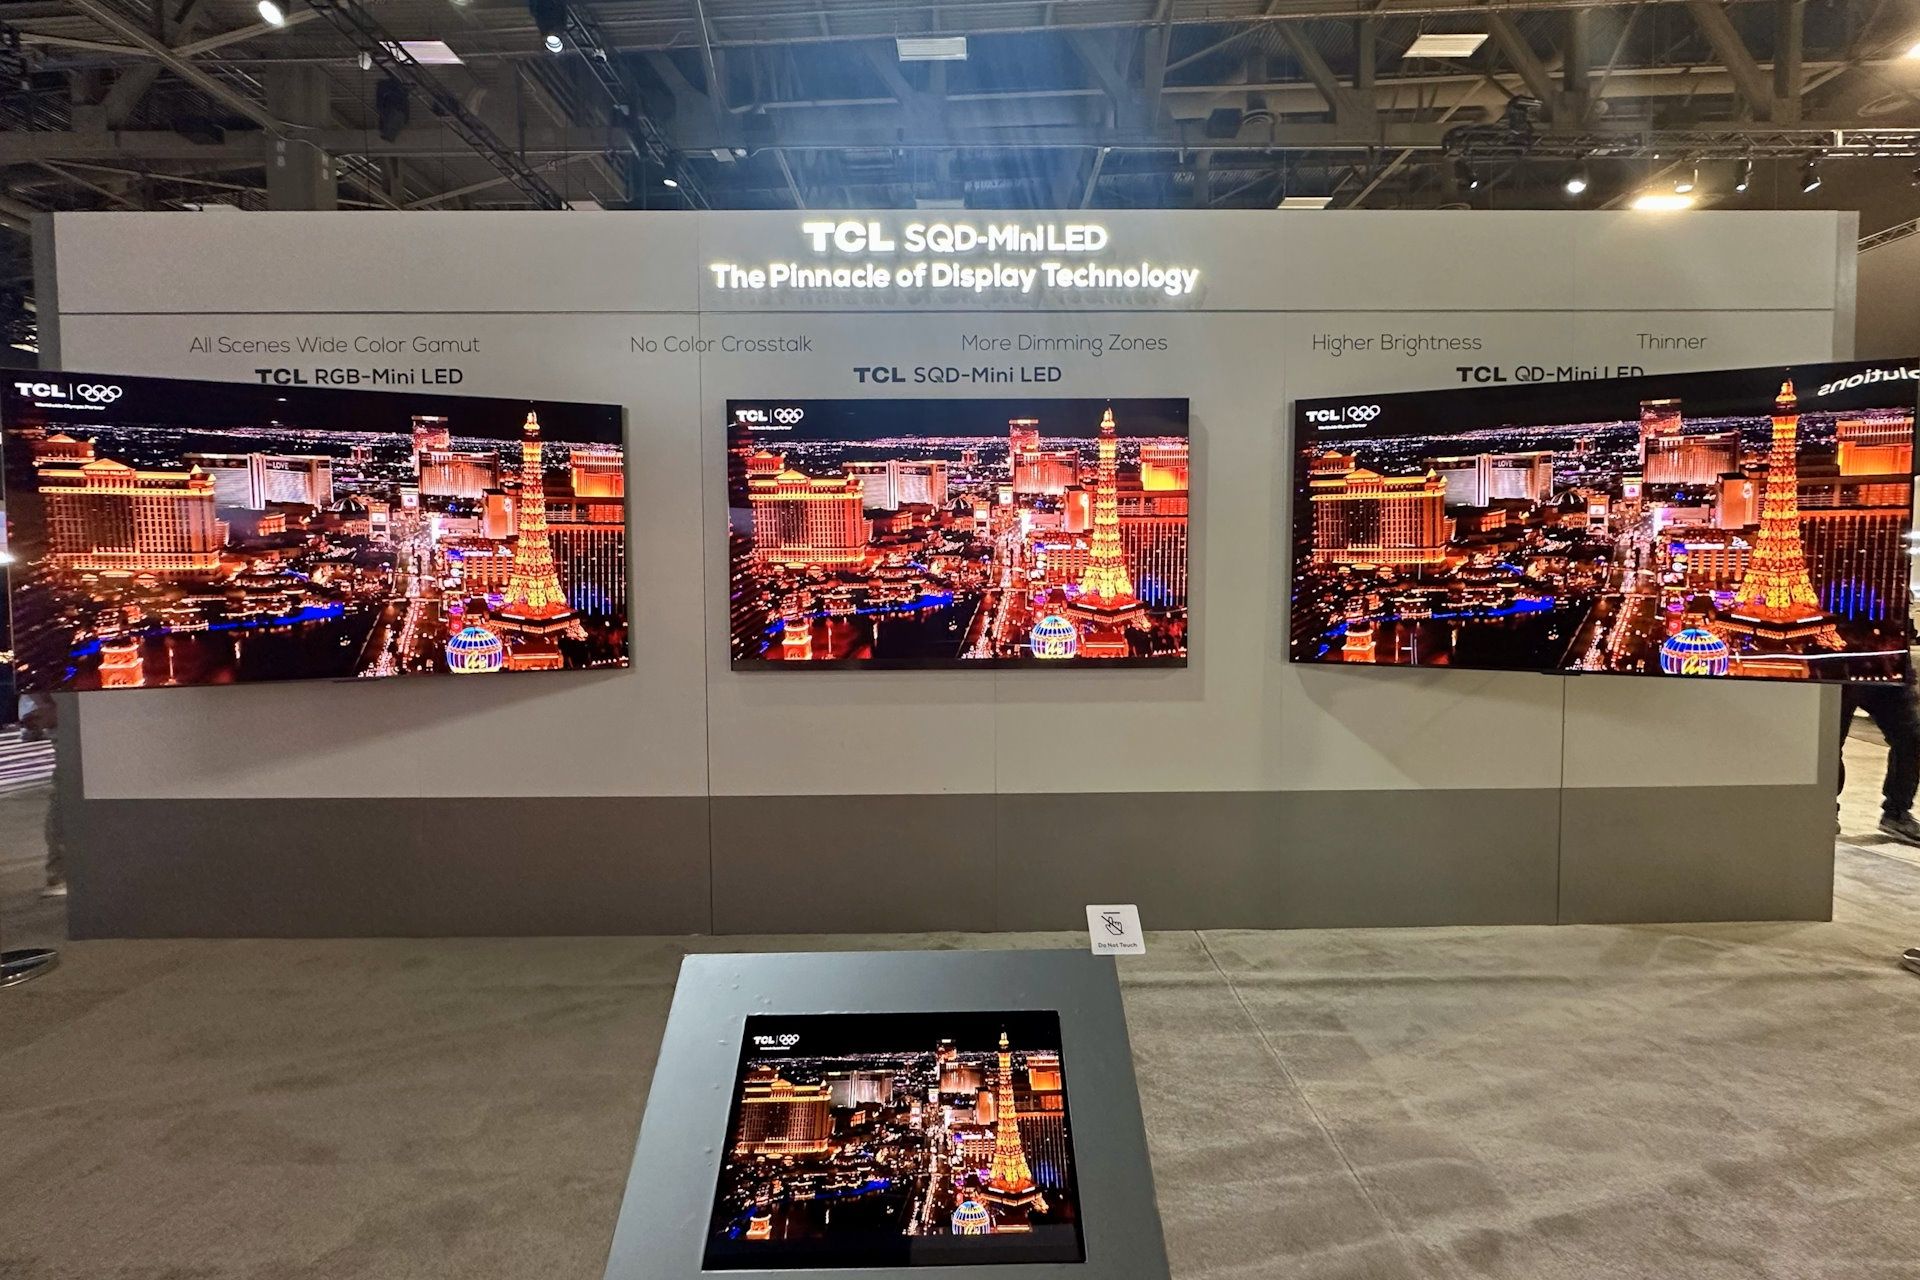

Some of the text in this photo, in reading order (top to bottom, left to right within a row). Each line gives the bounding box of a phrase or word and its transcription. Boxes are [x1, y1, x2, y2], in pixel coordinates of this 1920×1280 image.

[803, 222, 895, 252] TCL
[1047, 224, 1108, 251] LED
[710, 261, 1199, 296] The Pinnacle of Display Technology
[189, 336, 481, 353] All Scenes Wide Color Gamut
[631, 335, 813, 352] No Color Crosstalk
[961, 334, 1168, 357] More Dimming Zones
[1312, 333, 1482, 357] Higher Brightness
[1636, 333, 1707, 350] Thinner
[254, 368, 463, 385] TCL RGB-Mini LED
[853, 366, 1062, 383] TCL SQD-Mini LED
[1456, 365, 1507, 383] TCL
[1515, 365, 1598, 382] QD-Mini
[14, 382, 67, 398] TCL
[735, 409, 768, 423] TCL
[1305, 409, 1340, 423] TCL
[272, 461, 289, 470] LOVE
